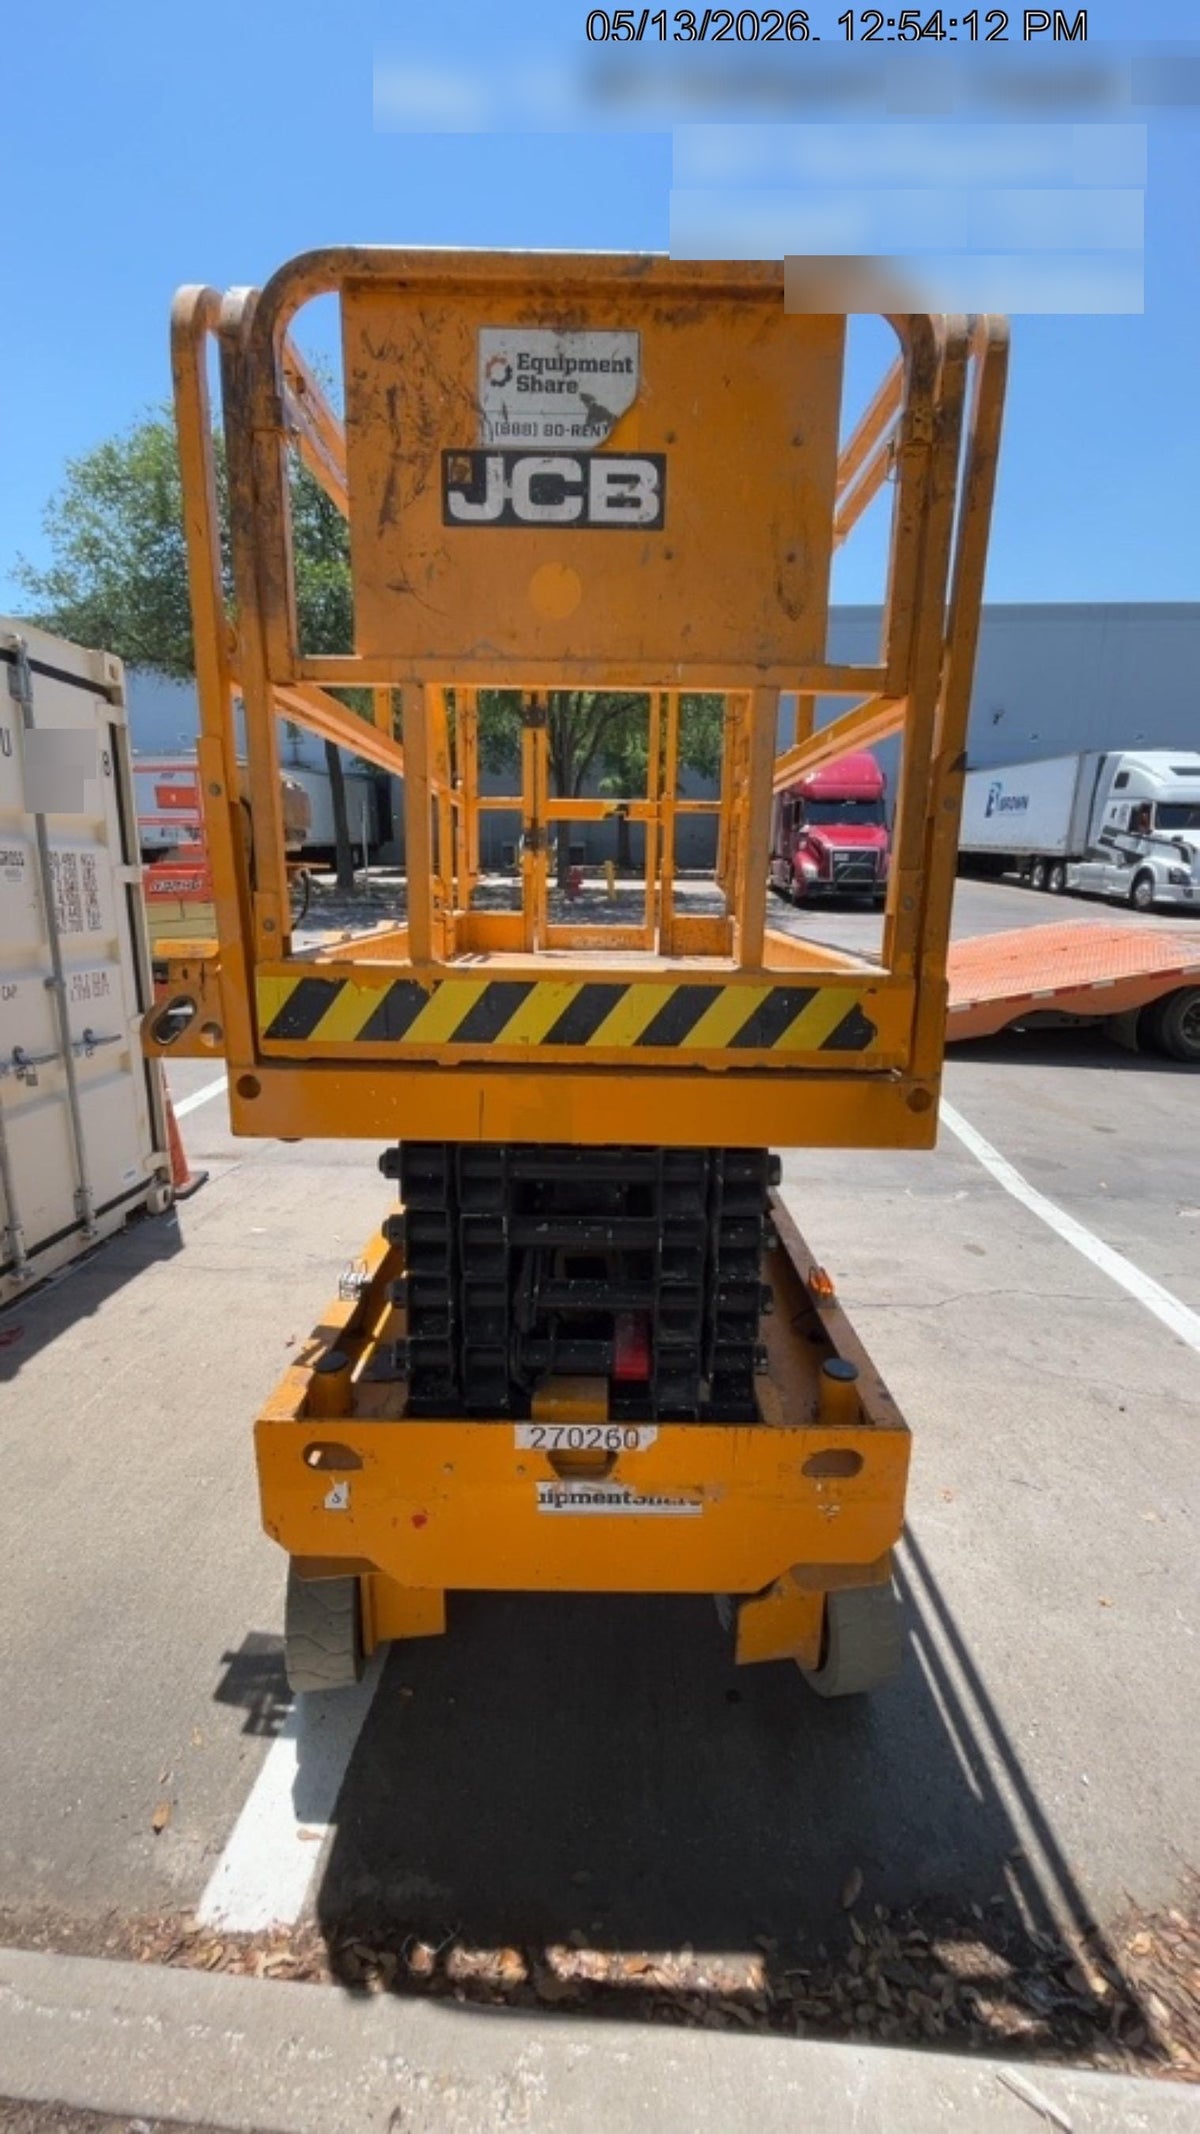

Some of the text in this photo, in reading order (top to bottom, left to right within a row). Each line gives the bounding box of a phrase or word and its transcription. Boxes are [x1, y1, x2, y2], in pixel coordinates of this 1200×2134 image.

[516, 353, 634, 376] Equipment
[516, 375, 579, 394] Share
[447, 456, 661, 522] JCB
[530, 1426, 640, 1450] 270260
